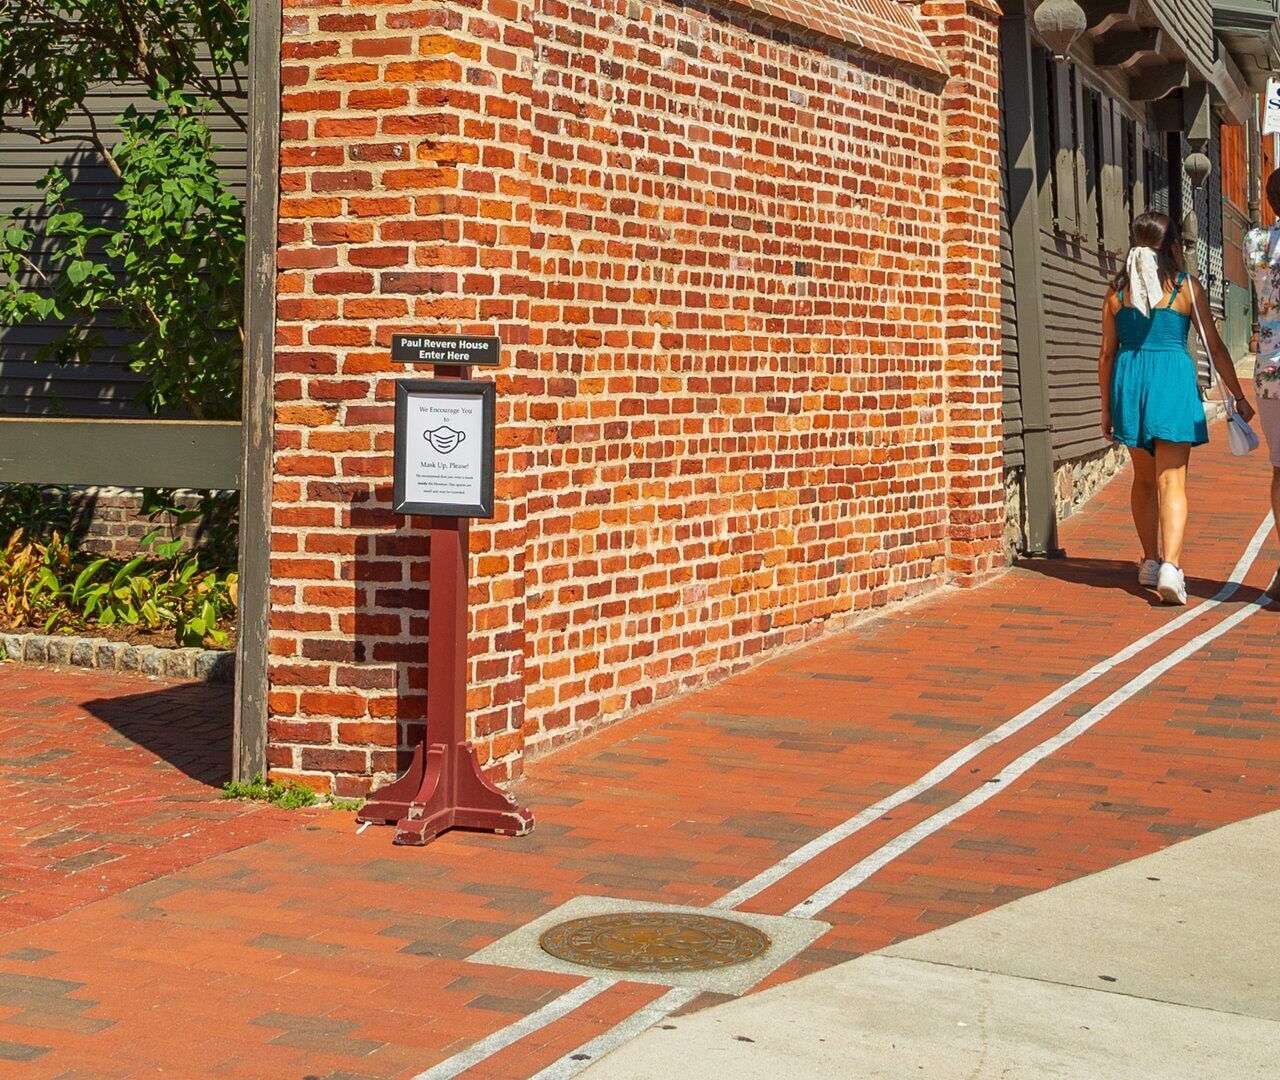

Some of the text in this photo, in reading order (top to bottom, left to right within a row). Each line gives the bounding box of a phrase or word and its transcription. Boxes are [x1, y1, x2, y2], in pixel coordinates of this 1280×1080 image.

[401, 338, 489, 350] Paul Revere House
[419, 350, 470, 361] Enter Here
[429, 406, 460, 414] Encourage
